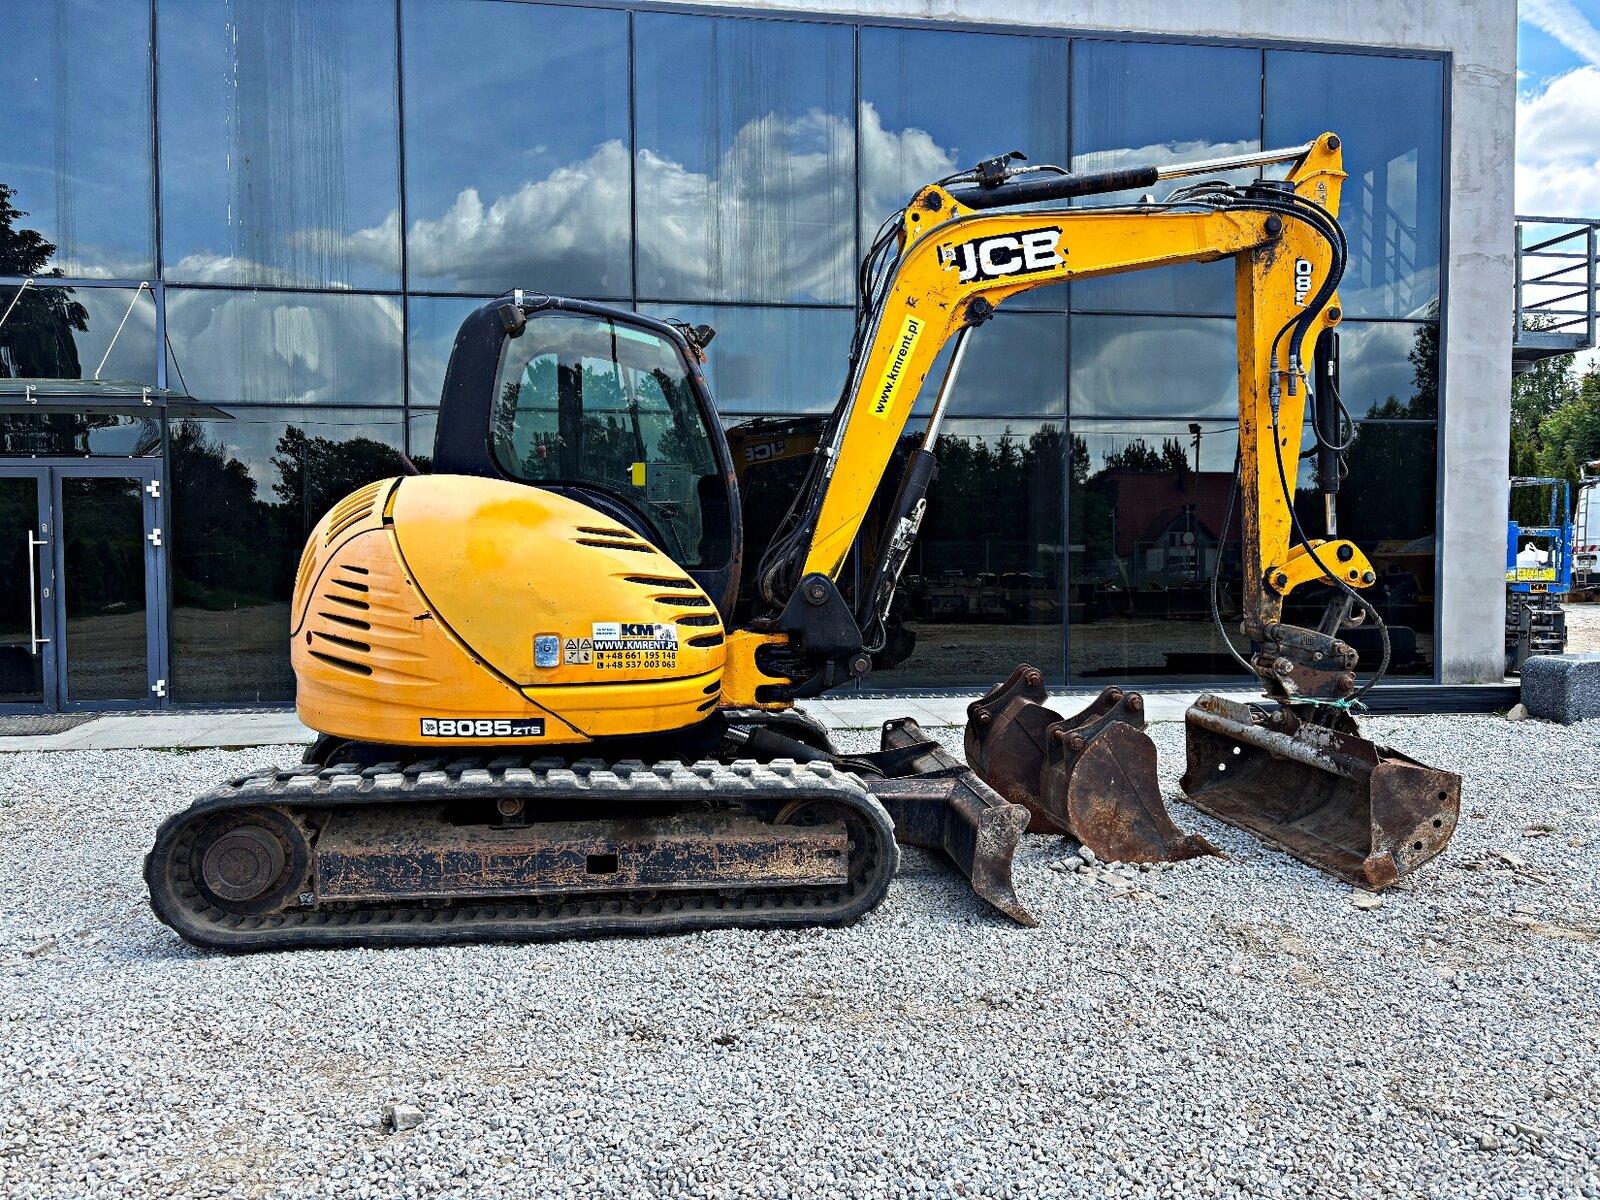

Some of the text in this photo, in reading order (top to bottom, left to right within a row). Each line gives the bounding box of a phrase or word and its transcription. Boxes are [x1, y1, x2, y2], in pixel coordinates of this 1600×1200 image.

[943, 230, 1065, 281] JCB
[875, 319, 919, 413] www.kmrent.pl
[621, 624, 654, 636] KM
[594, 640, 678, 650] WWW.KMRENT.PL
[606, 661, 623, 669] +48
